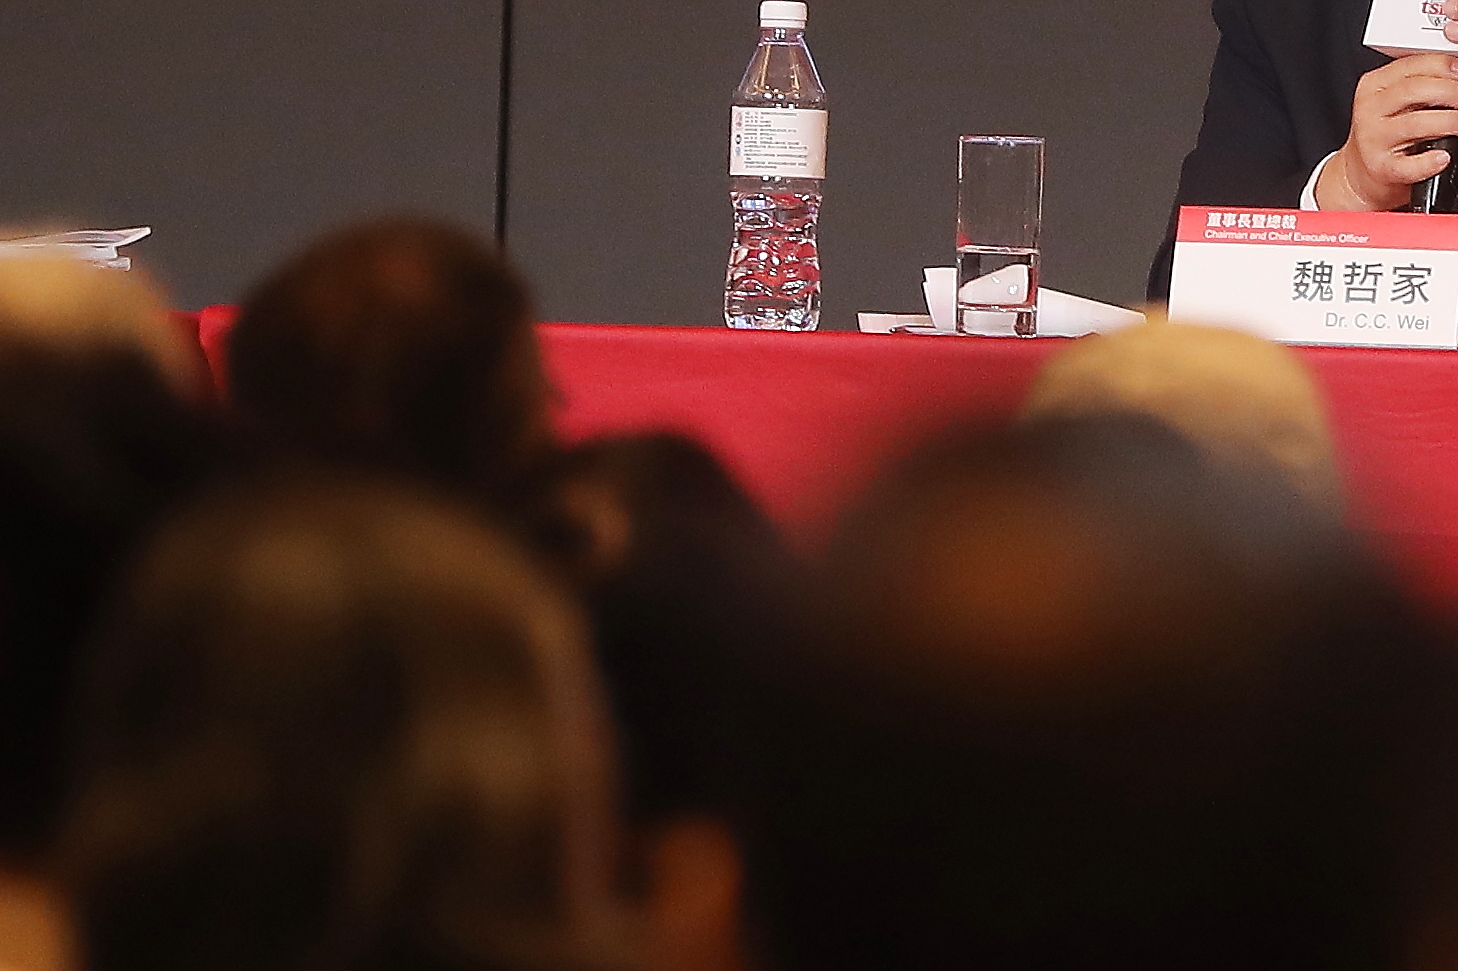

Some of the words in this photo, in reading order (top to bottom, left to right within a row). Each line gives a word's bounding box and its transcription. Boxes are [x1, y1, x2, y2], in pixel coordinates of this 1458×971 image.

[1204, 229, 1247, 240] Chairman
[1249, 231, 1267, 240] and
[1268, 231, 1292, 241] Chief
[1294, 232, 1336, 242] Executive
[1338, 233, 1369, 243] Officer
[1292, 261, 1432, 304] 魏哲家
[1325, 312, 1348, 327] Dr.
[1354, 313, 1391, 329] C.C.
[1398, 314, 1430, 330] Wei
